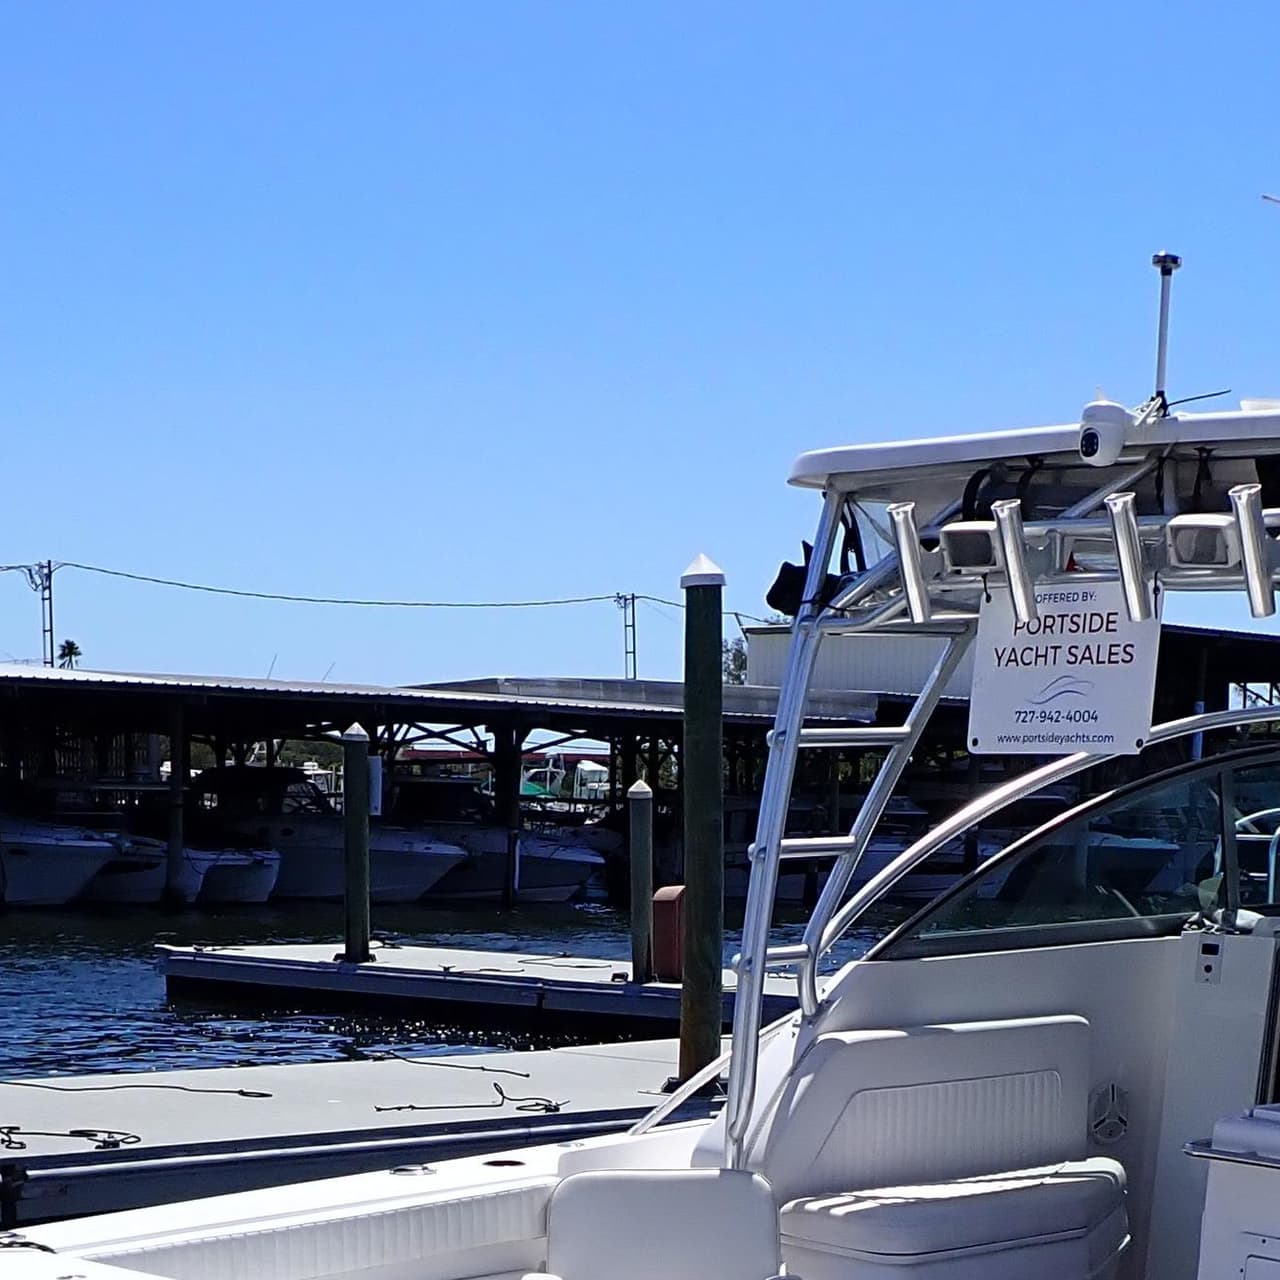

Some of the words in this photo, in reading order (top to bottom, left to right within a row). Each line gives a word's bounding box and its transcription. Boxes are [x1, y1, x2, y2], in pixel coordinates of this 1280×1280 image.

[1035, 592, 1080, 604] OFFERED
[1082, 591, 1097, 602] BY:
[994, 645, 1062, 667] YACHT
[1066, 643, 1135, 665] SALES
[1015, 710, 1098, 723] 727-942-4004
[997, 733, 1114, 744] www.portsideyachts.com
